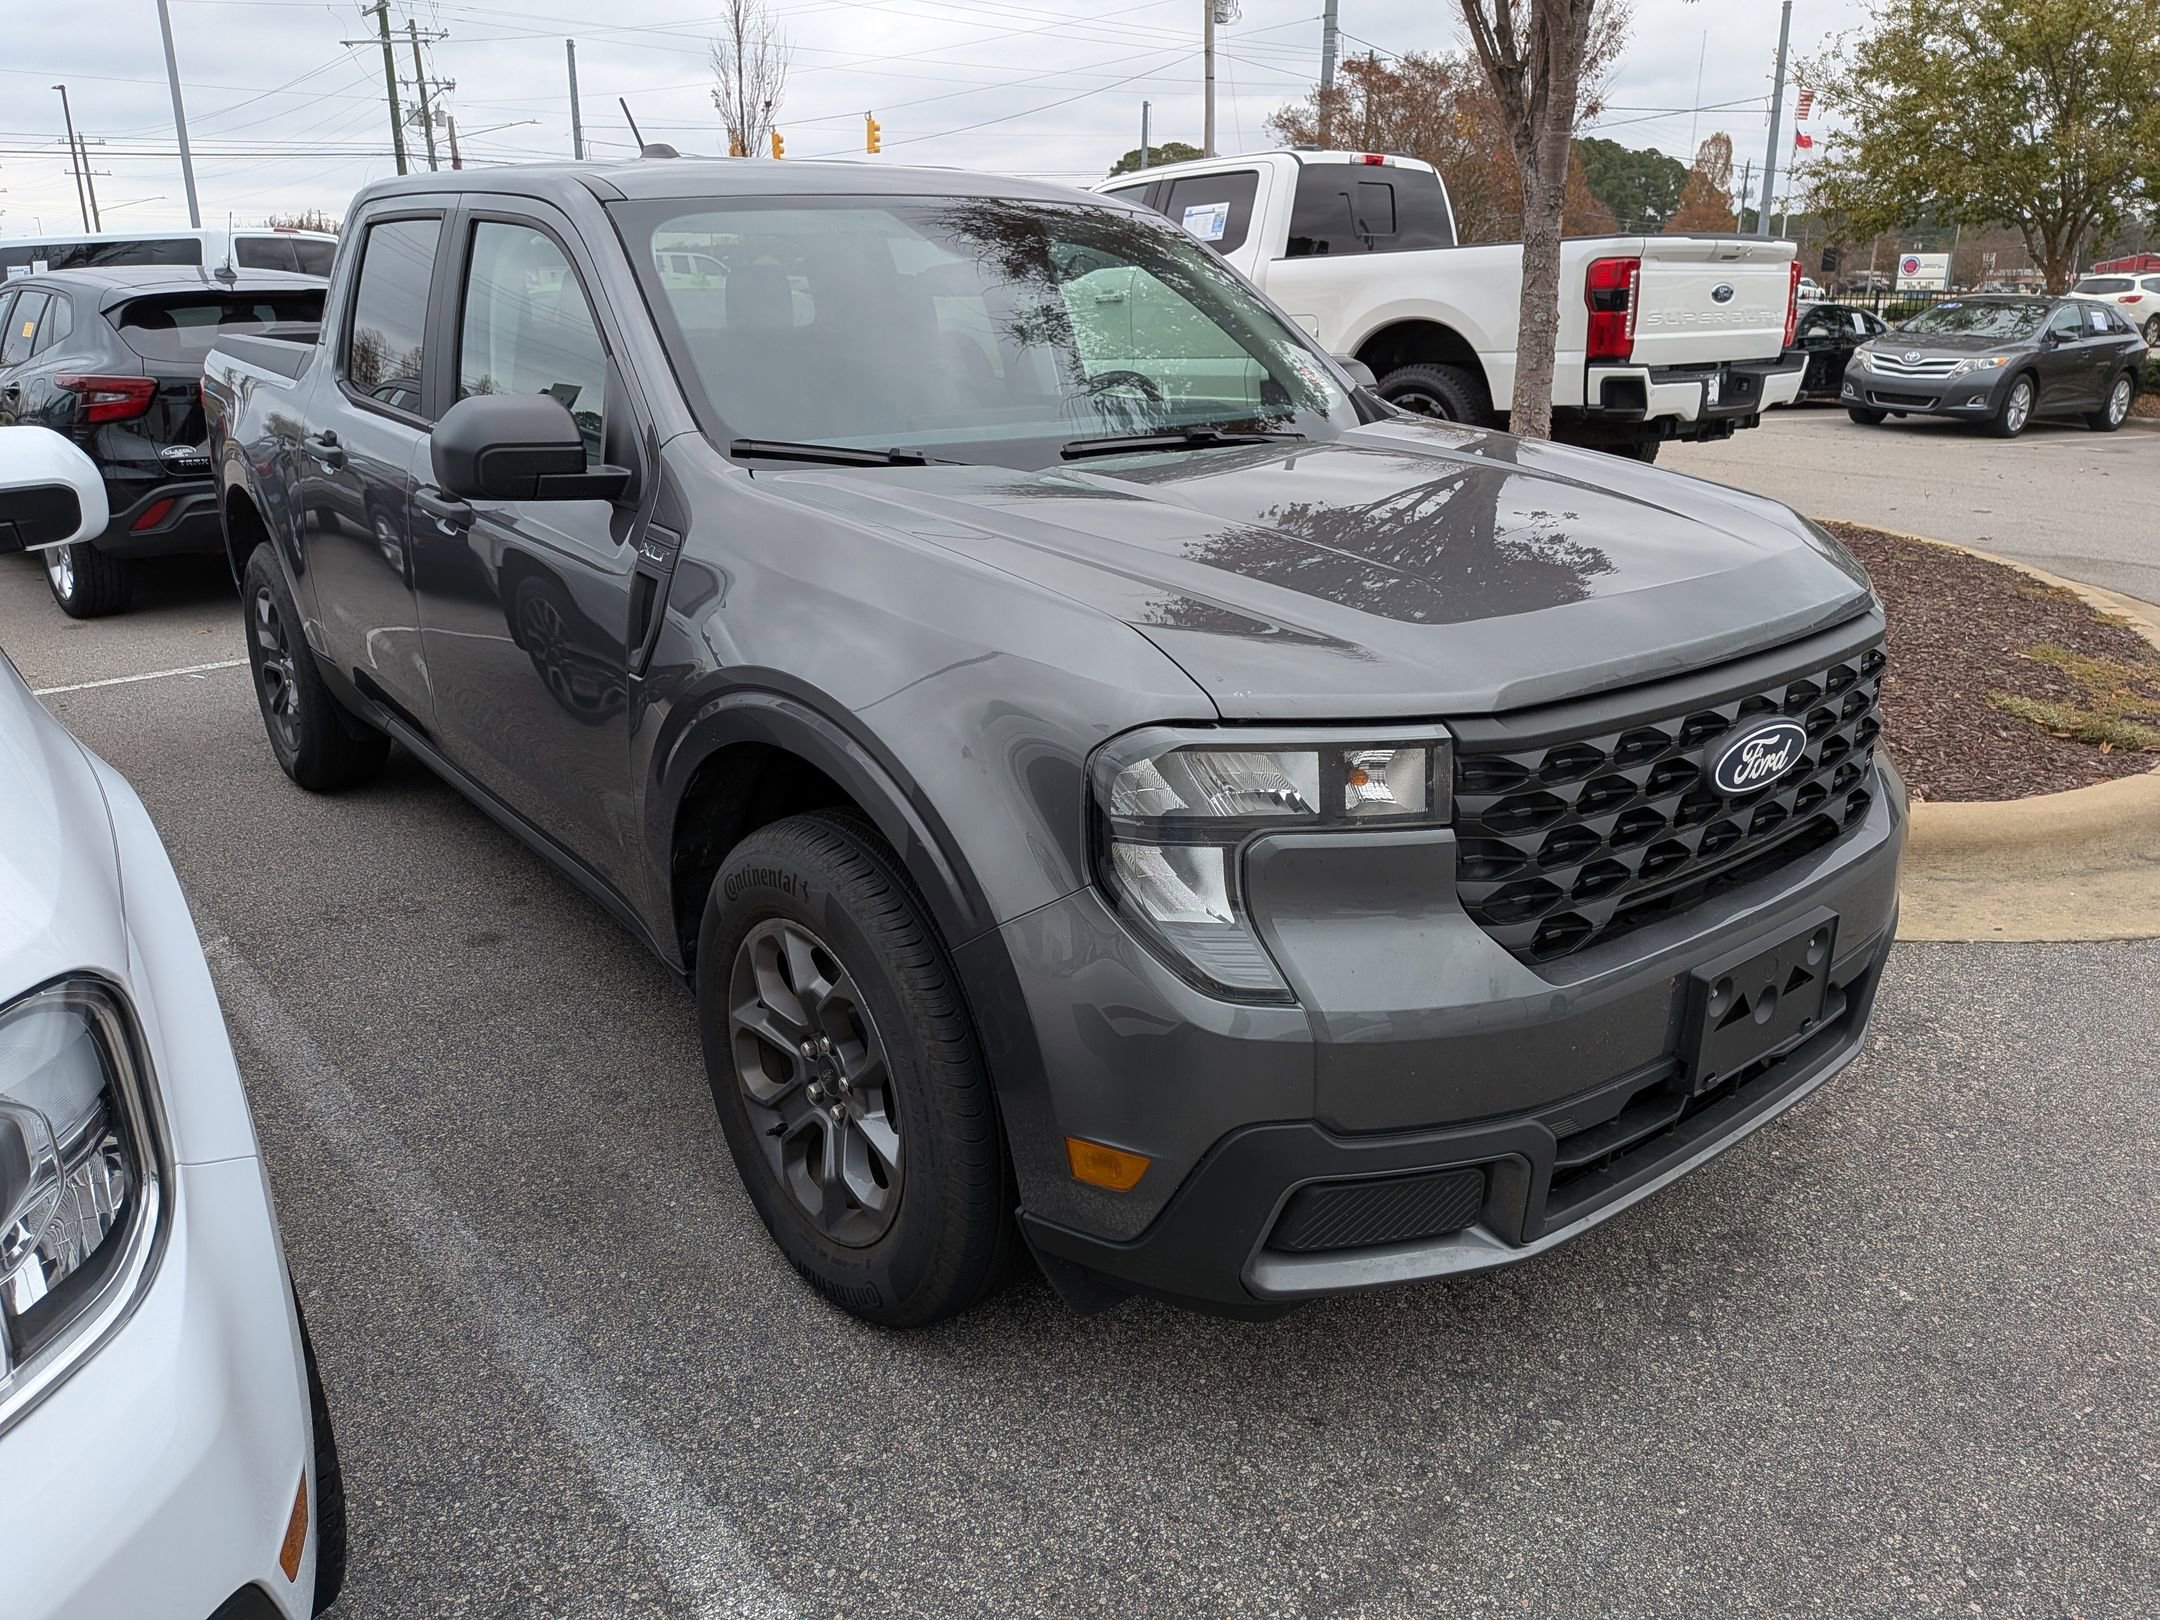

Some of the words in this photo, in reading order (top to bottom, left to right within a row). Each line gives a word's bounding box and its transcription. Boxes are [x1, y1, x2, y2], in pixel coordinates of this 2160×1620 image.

[1646, 312, 1726, 325] SUPER
[1731, 310, 1782, 322] DUTY
[178, 458, 209, 466] TRAX
[640, 542, 670, 562] XLT
[1734, 734, 1793, 785] Ford
[724, 863, 798, 902] Continental
